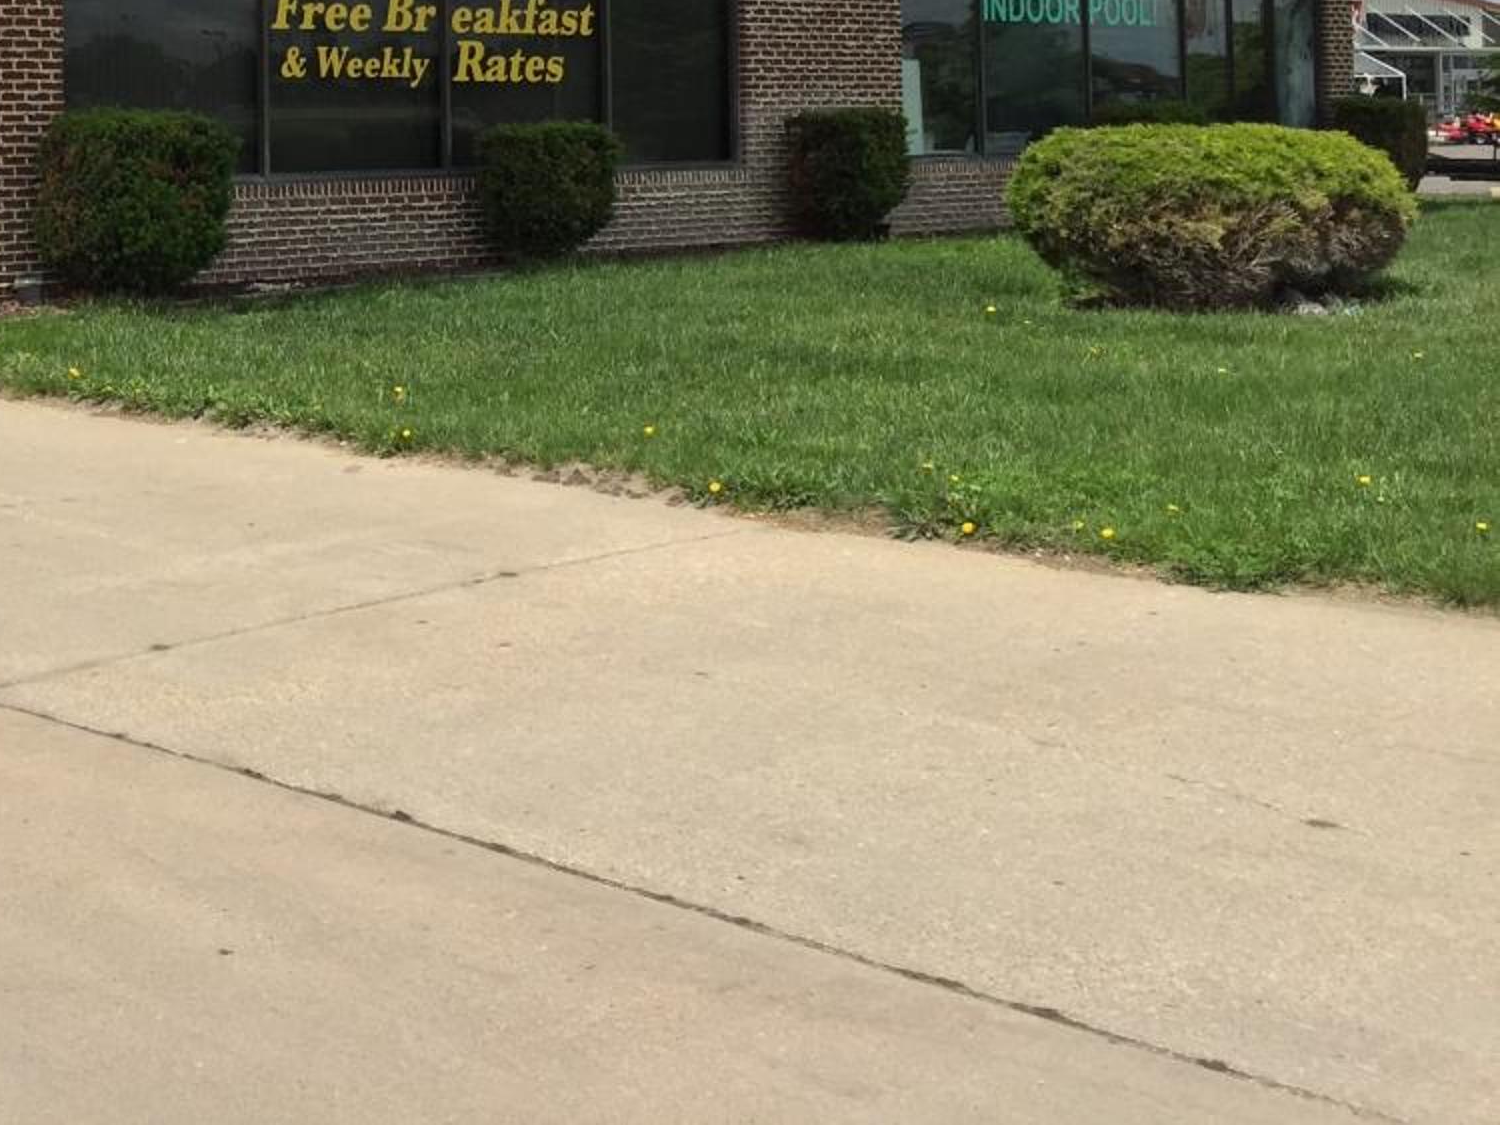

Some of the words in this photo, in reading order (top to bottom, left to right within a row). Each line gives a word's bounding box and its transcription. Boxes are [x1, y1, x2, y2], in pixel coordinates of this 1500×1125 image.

[281, 46, 306, 78] &
[316, 46, 430, 88] Weekly
[453, 40, 565, 83] Rates
